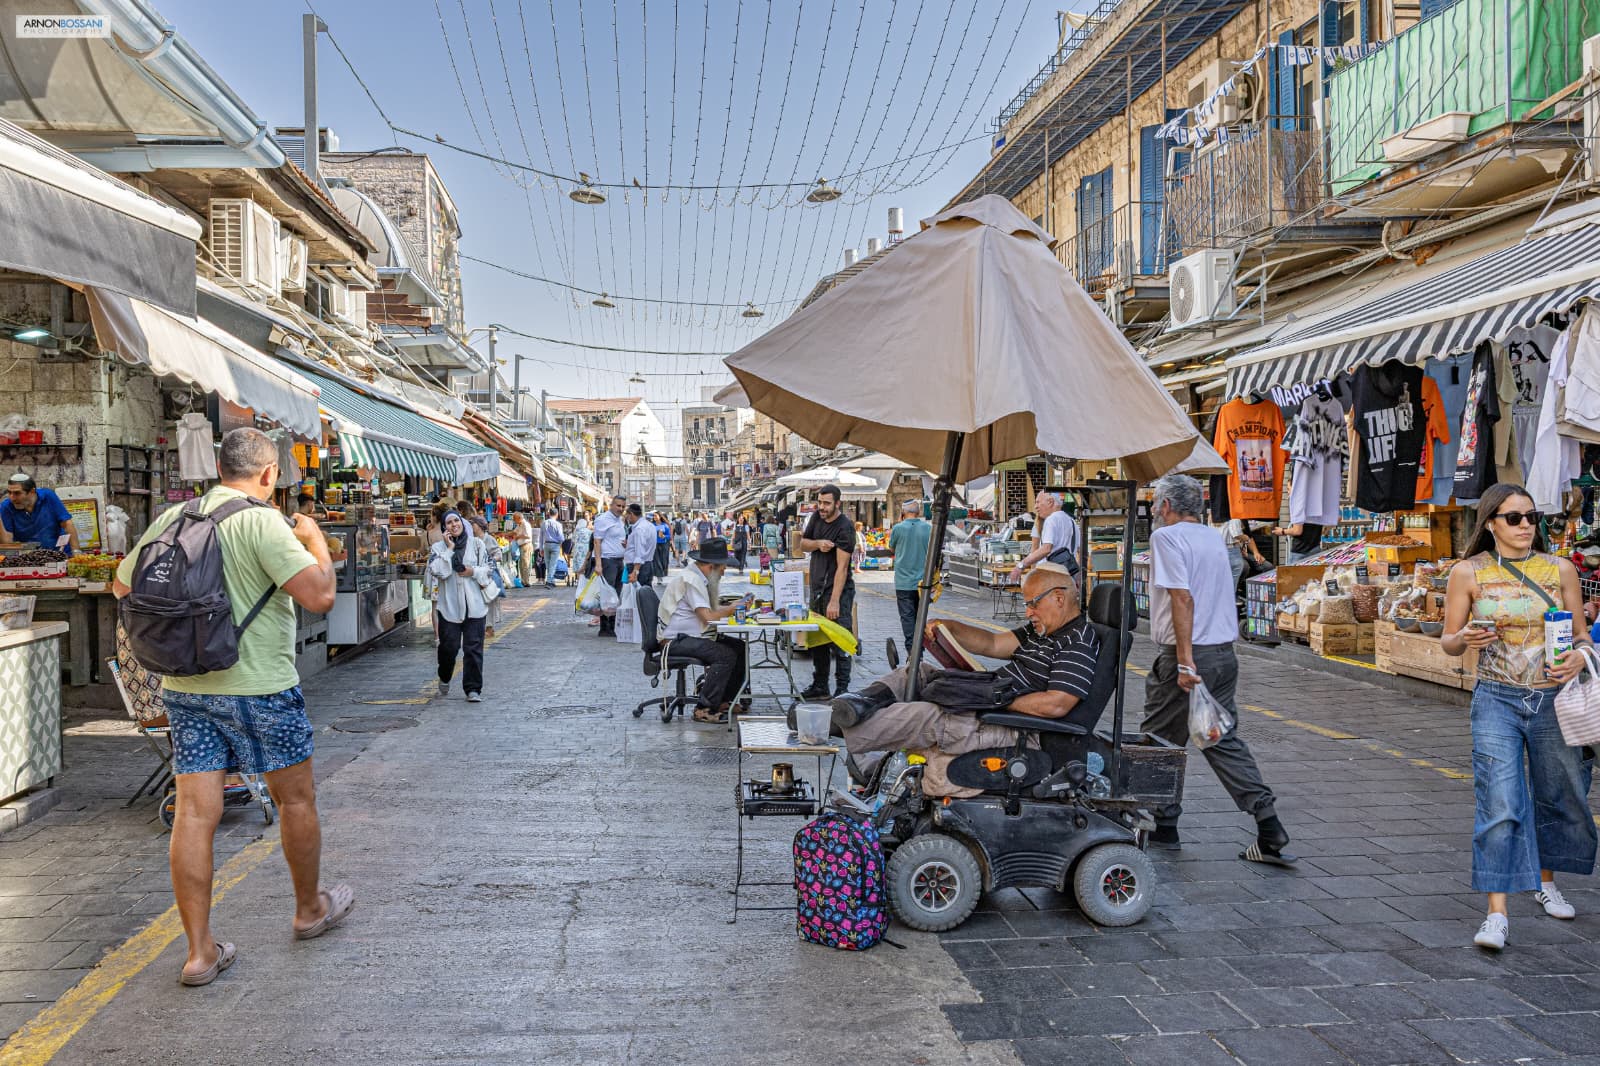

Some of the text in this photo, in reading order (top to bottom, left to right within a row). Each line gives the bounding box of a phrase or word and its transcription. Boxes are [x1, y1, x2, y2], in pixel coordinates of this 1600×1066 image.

[1271, 379, 1333, 407] MARKT
[1227, 424, 1279, 444] CHAMPIONS
[1364, 407, 1410, 437] THUG
